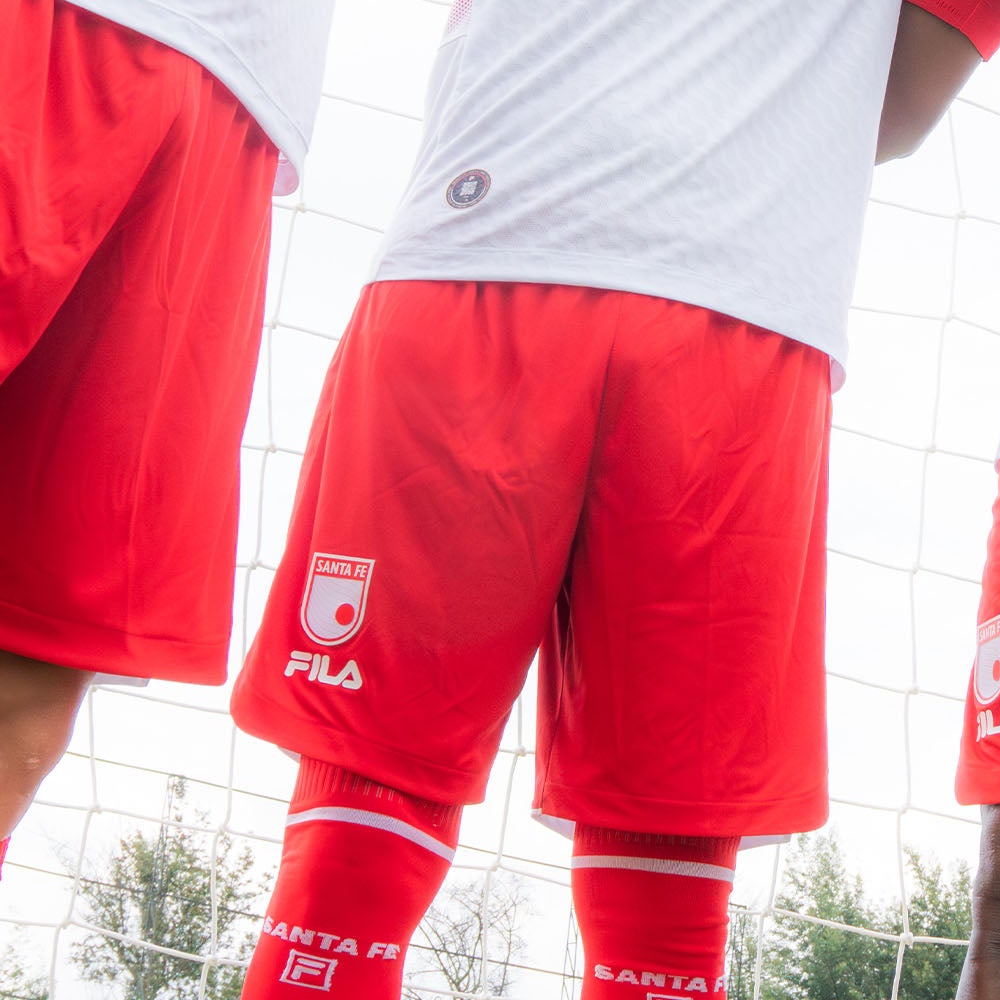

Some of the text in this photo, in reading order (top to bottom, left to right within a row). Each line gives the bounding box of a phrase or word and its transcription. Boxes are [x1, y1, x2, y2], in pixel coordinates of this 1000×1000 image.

[316, 560, 368, 578] SANTA FE
[284, 650, 363, 690] FILA
[263, 916, 401, 960] SANTA FE
[594, 964, 708, 993] SANTA
